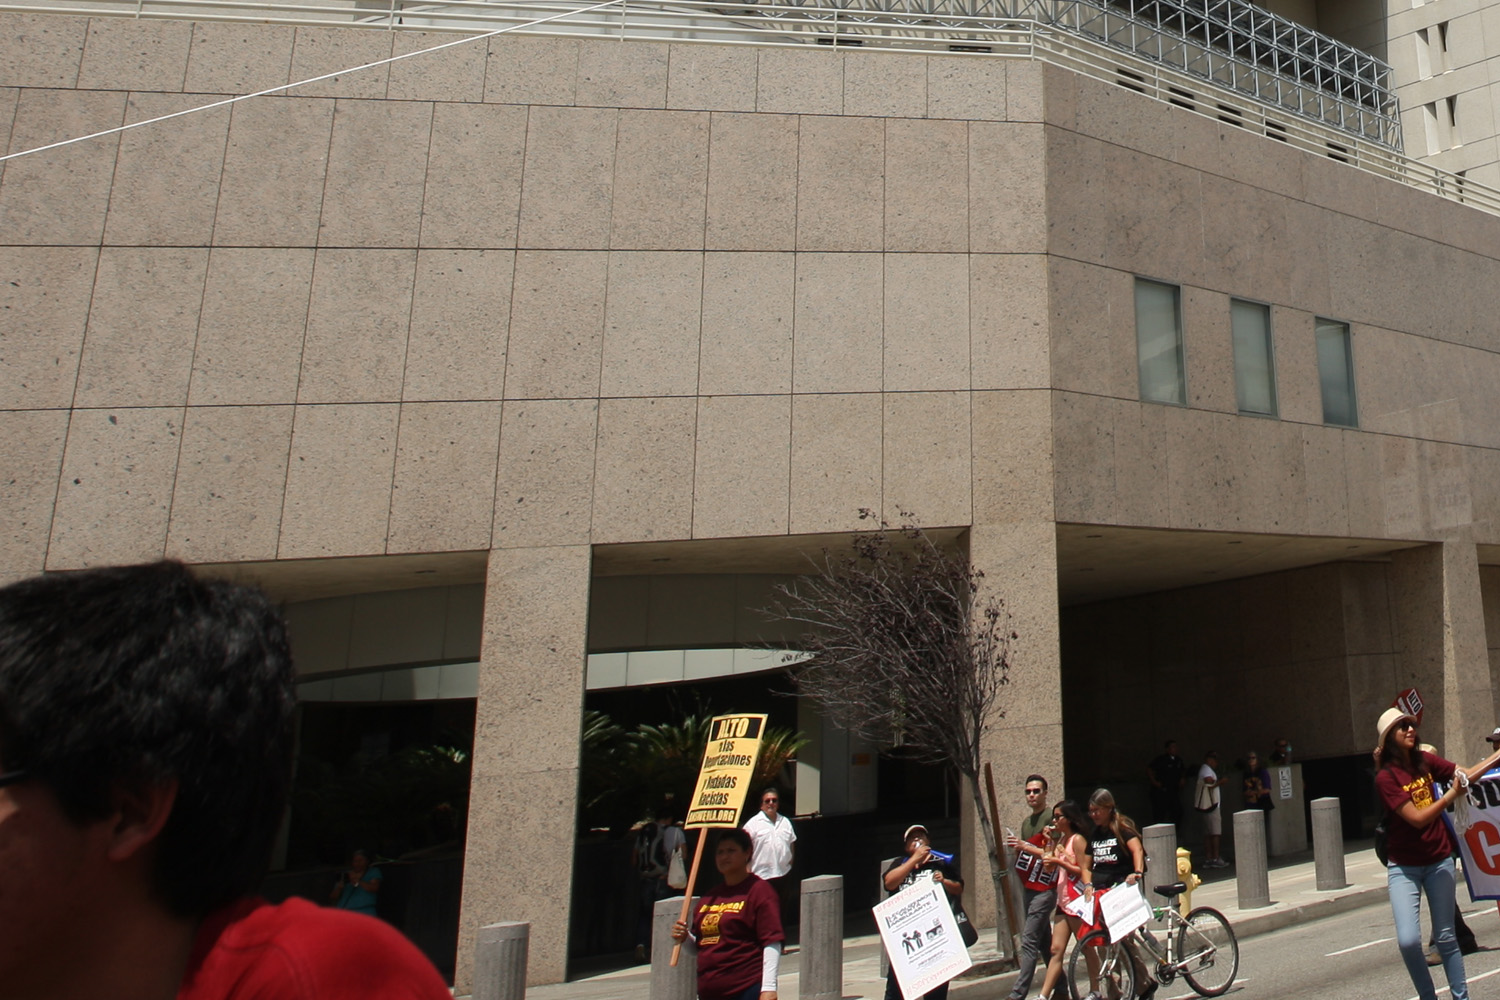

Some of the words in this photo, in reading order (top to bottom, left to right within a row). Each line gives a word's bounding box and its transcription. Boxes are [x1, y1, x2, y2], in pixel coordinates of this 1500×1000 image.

[717, 717, 749, 739] ALTO
[723, 739, 735, 752] las
[1016, 850, 1033, 871] ALT
